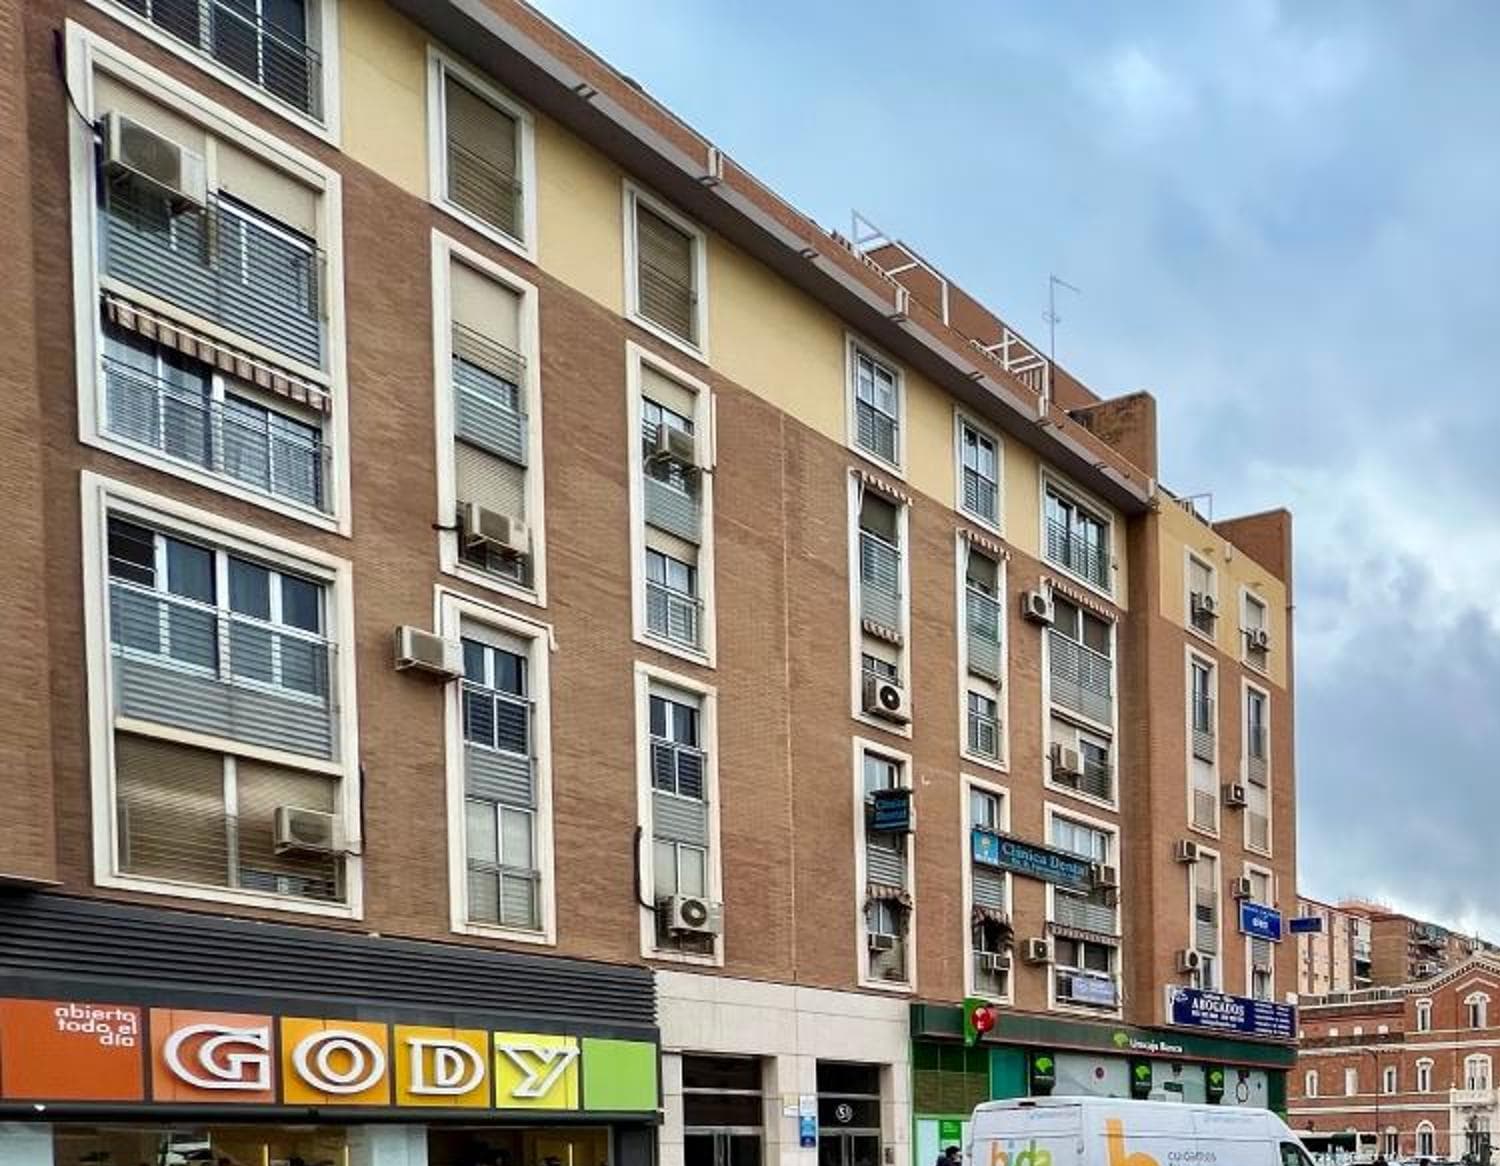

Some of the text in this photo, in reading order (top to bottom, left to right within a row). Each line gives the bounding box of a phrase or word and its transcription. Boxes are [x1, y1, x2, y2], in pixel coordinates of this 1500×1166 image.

[55, 1003, 136, 1021] abierto
[58, 1018, 137, 1035] todo el
[164, 1023, 579, 1098] GODY
